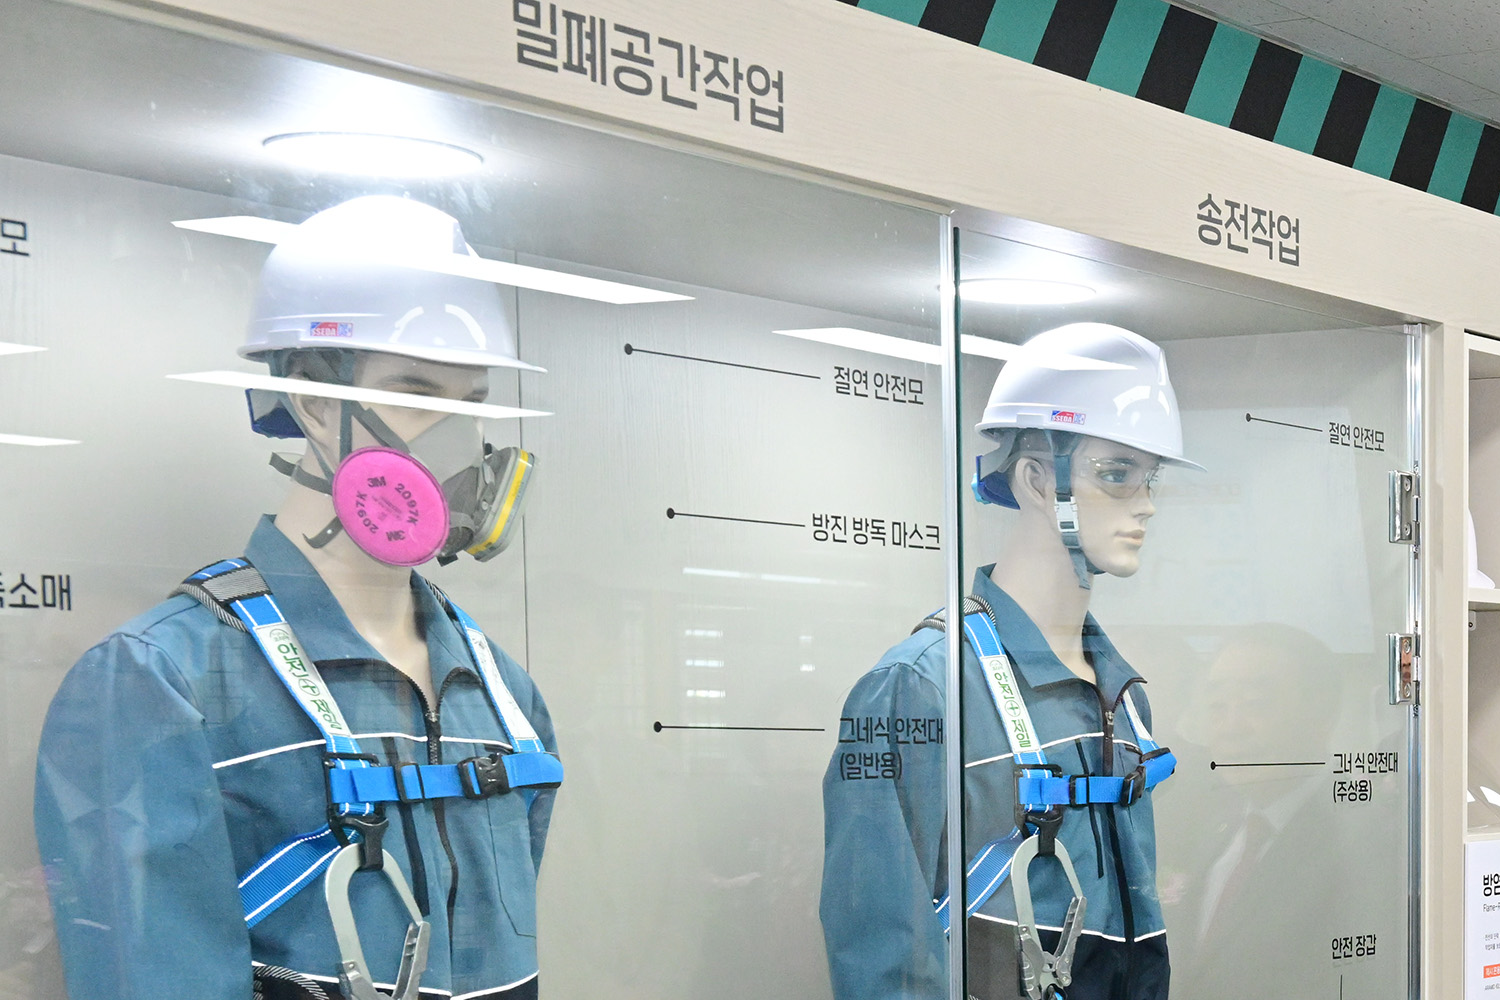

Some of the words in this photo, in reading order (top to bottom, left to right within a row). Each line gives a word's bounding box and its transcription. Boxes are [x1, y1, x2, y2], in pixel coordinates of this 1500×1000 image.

[513, 0, 784, 133] 밀폐공간작업
[1, 218, 30, 256] 모
[1197, 193, 1300, 267] 송전작업
[834, 366, 868, 398] 절연
[873, 372, 924, 405] 안전모
[1329, 422, 1351, 447] 절연
[1353, 426, 1385, 452] 안전모
[367, 476, 387, 488] 3M
[355, 491, 380, 534] 2097K
[394, 483, 419, 527] 2097K
[386, 530, 406, 542] 3M
[812, 513, 847, 543] 방진
[852, 517, 886, 547] 방독
[891, 521, 941, 550] 마스크
[0, 572, 71, 611] 소매
[838, 717, 890, 743] 그네식
[895, 718, 944, 744] 안전대
[1011, 718, 1032, 748] 제일
[840, 752, 902, 780] (일반용)
[1367, 752, 1398, 773] 안전대
[1333, 780, 1373, 803] (주상용)
[1332, 937, 1353, 960] 안전
[1355, 934, 1377, 957] 장갑
